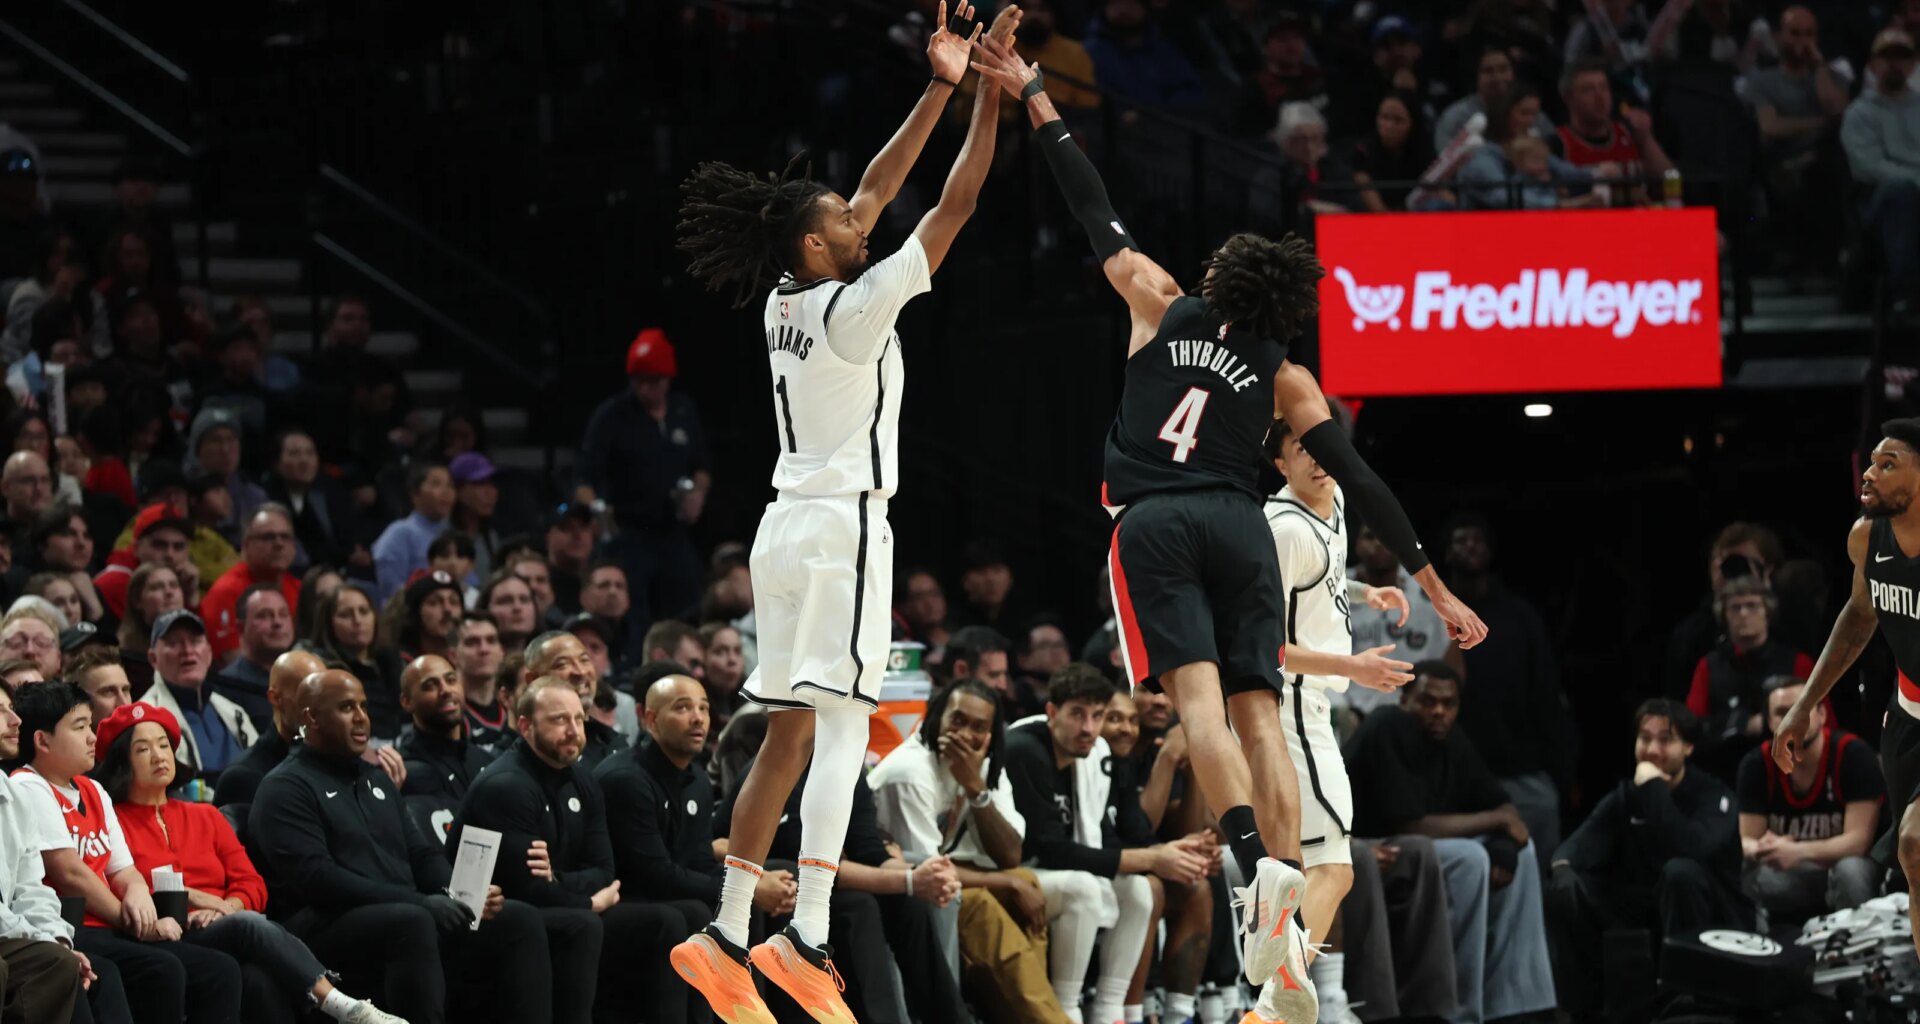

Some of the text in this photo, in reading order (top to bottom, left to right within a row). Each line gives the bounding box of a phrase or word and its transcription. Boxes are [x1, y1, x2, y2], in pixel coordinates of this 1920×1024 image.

[1167, 340, 1259, 393] THYBULLE
[776, 375, 797, 454] 1
[1157, 386, 1211, 464] 4
